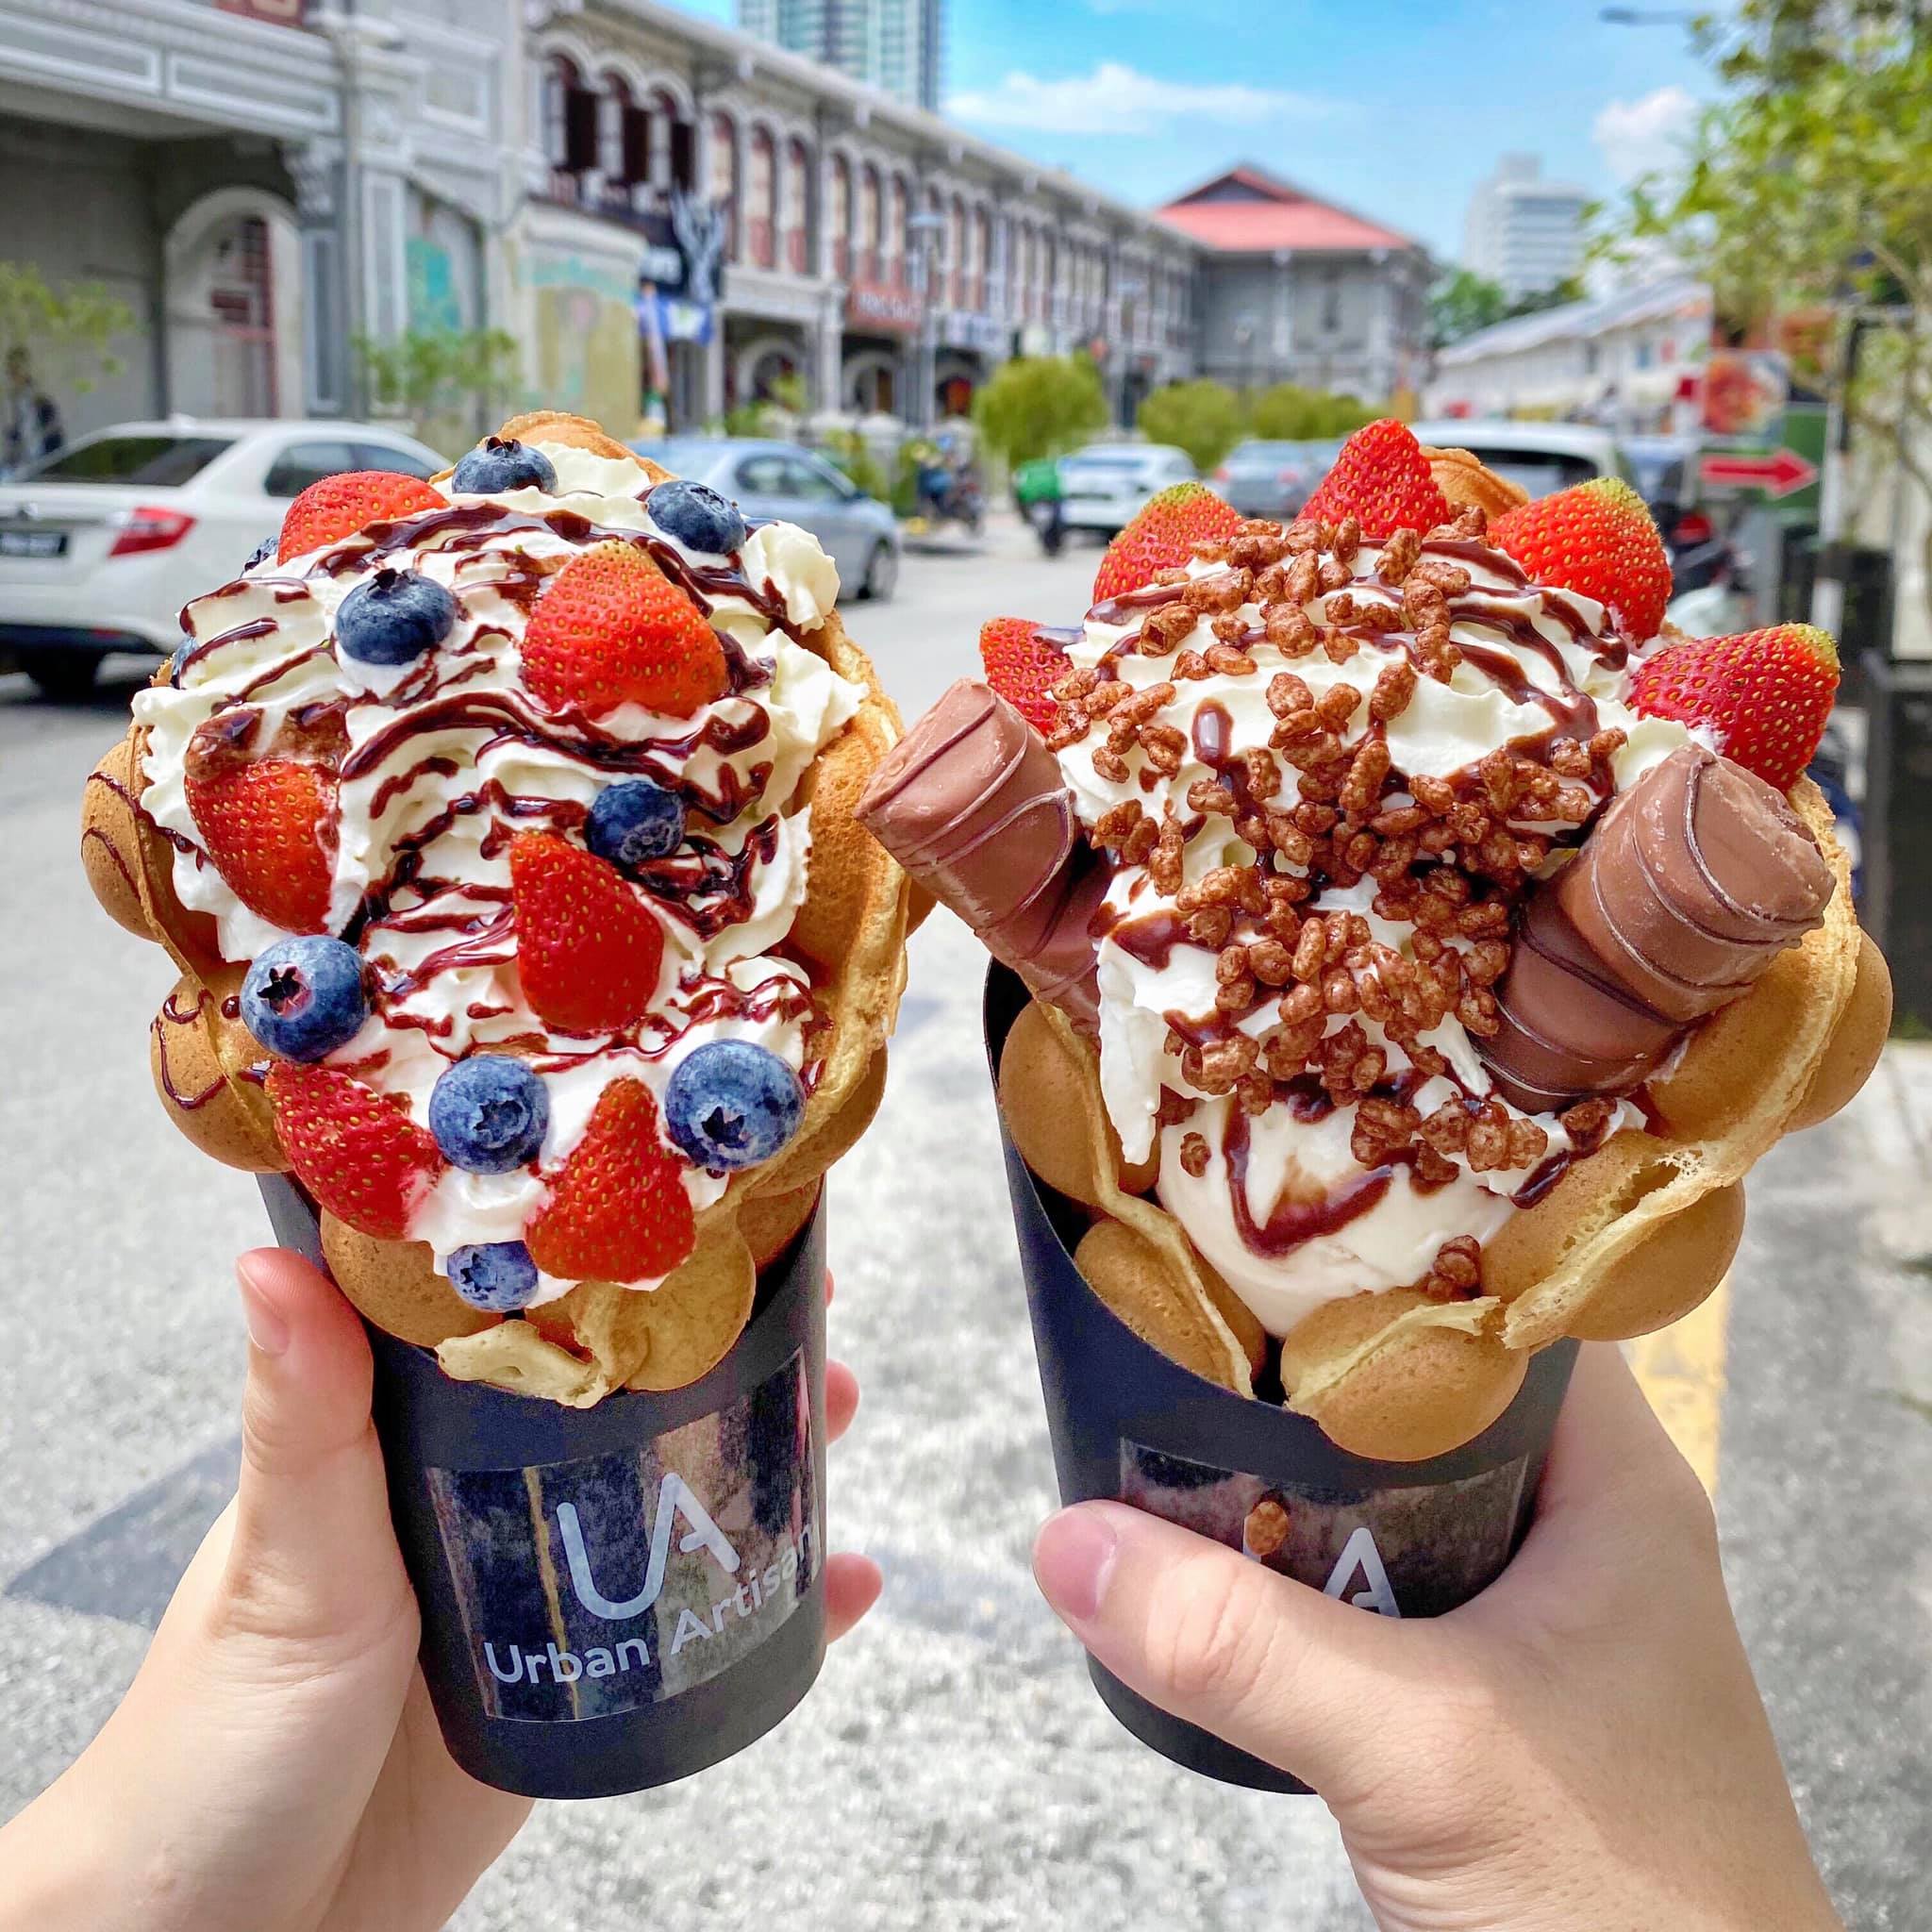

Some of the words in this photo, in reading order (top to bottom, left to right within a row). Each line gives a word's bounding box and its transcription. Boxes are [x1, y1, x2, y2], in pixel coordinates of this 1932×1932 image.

[484, 1635, 649, 1684] Urban
[671, 1524, 814, 1656] Artisan
[557, 1472, 741, 1620] UA
